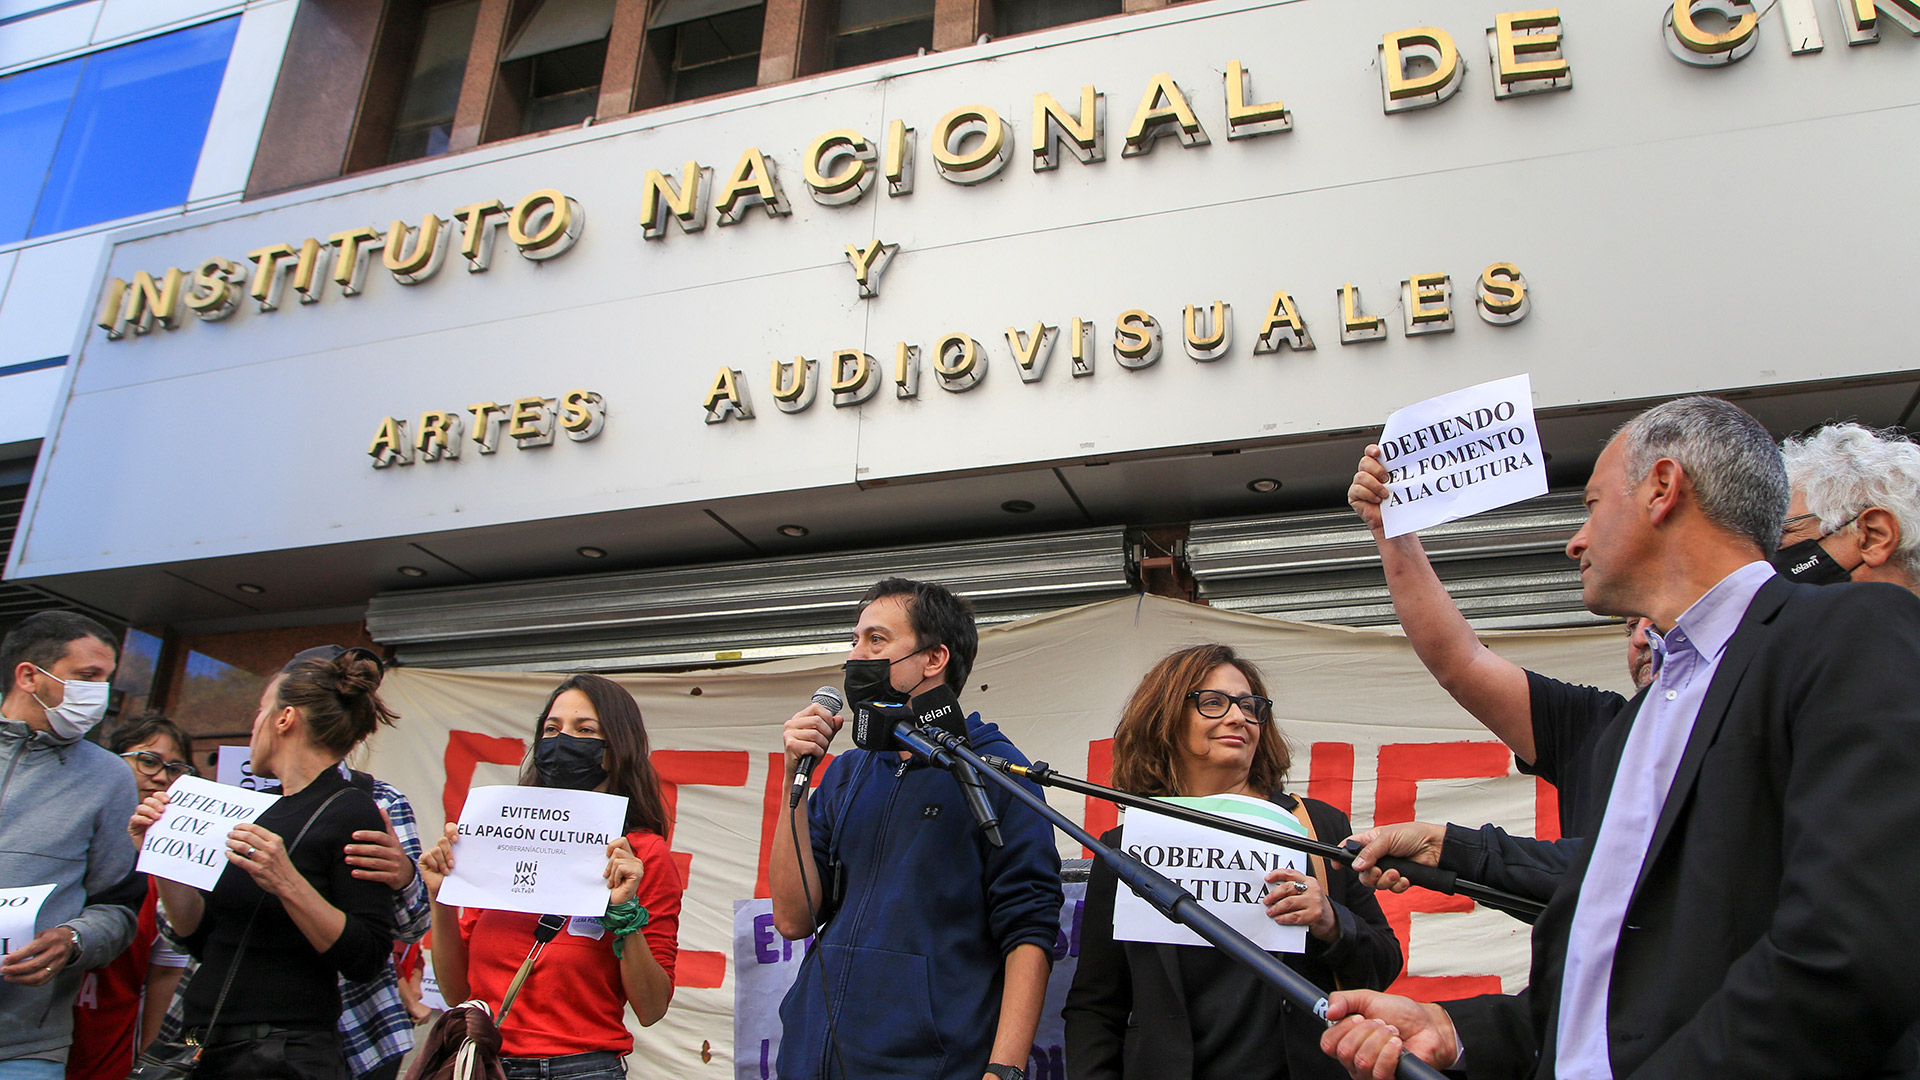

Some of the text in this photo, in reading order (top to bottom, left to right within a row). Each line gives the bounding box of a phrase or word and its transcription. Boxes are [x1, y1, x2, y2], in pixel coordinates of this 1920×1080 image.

[98, 0, 1920, 340] INSTITUTO NACIONAL DE CI
[844, 239, 899, 299] Y
[367, 261, 1532, 469] ARTES AUDIOVISUALES
[1381, 401, 1516, 463] DEFIENDO
[1387, 426, 1526, 485] EL FOMENTO
[1389, 451, 1535, 508] A LA CULTURA
[1791, 555, 1820, 576] télam
[169, 790, 255, 820] DEFIENDO
[500, 805, 571, 823] EVITEMOS
[170, 815, 214, 836] CINE
[457, 823, 612, 846] EL APAGÓN CULTURAL
[145, 834, 218, 868] ACIONAL
[497, 844, 568, 856] #SOBERANÍACULTURAL
[1128, 844, 1297, 873] SOBERANIA
